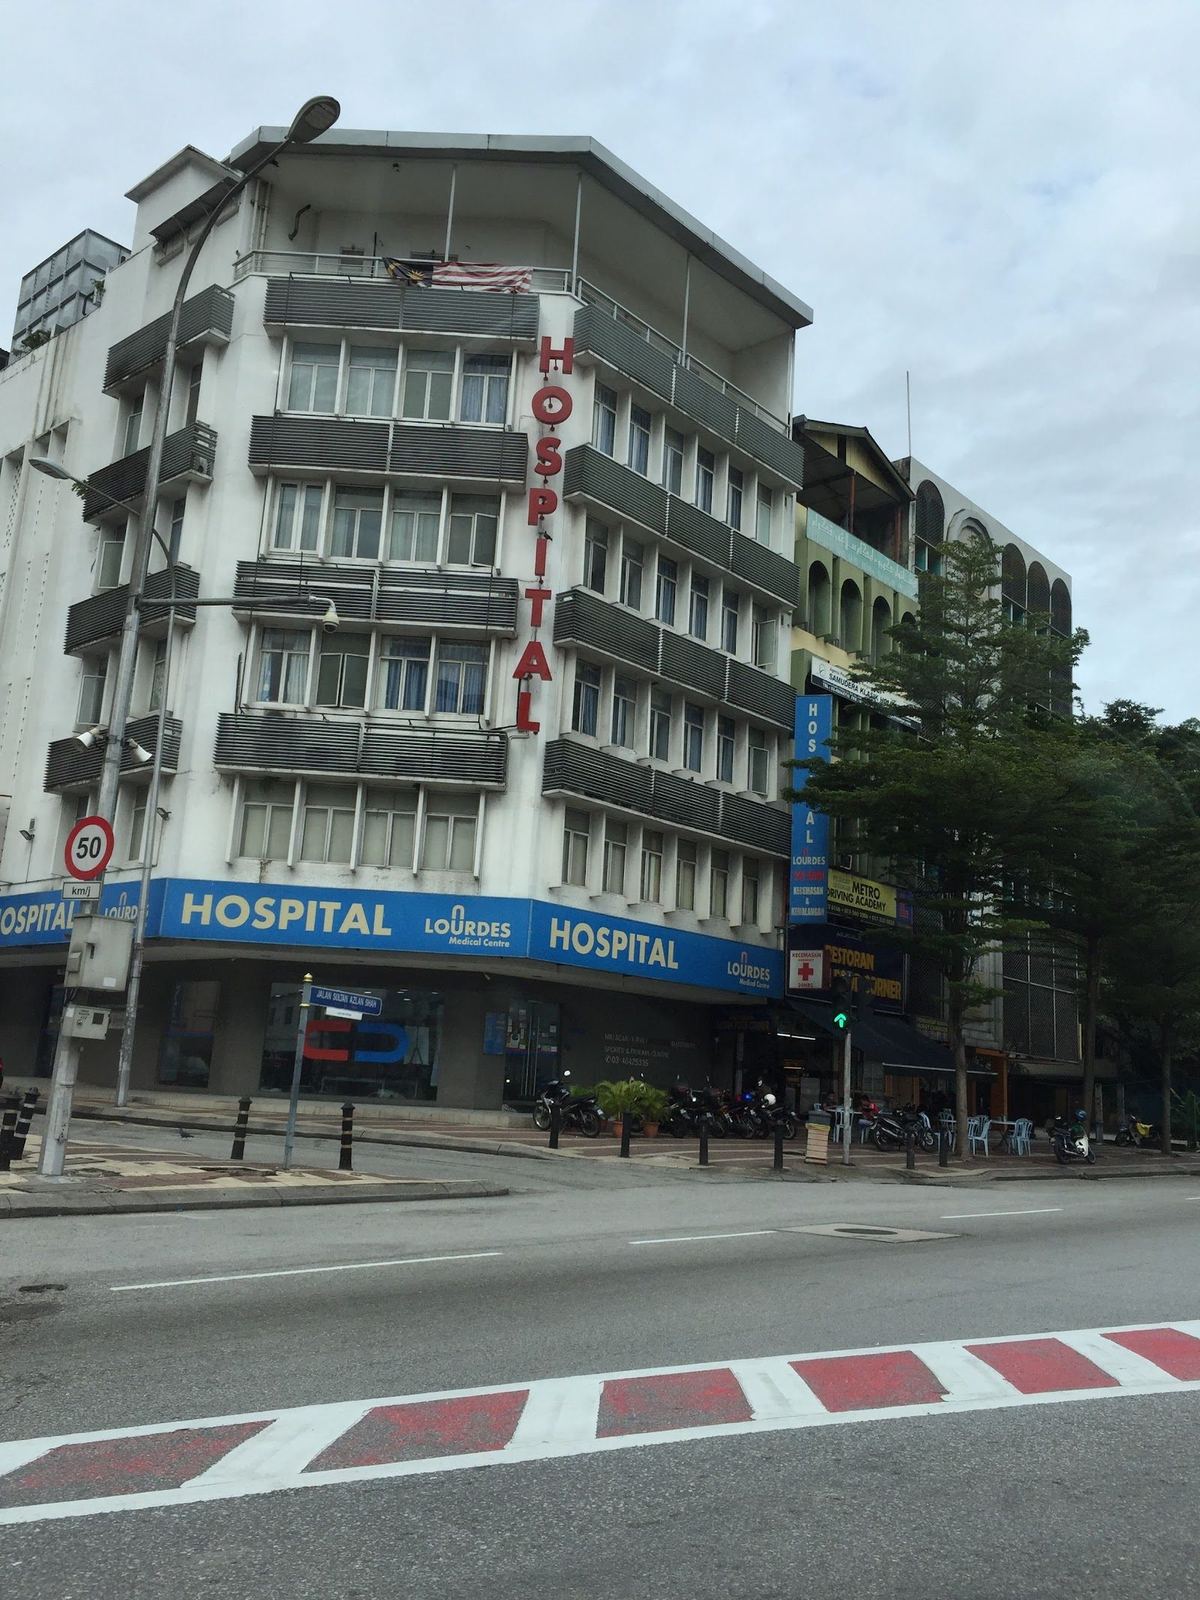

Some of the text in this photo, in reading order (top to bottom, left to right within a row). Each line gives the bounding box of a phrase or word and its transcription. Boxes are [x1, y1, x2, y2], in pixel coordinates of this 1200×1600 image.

[512, 336, 574, 734] HOSPITAL
[805, 703, 818, 844] HOSAL
[76, 837, 101, 859] 50
[792, 856, 826, 865] LOURDES
[71, 886, 91, 897] km/j
[852, 882, 881, 900] METRO
[181, 893, 392, 937] HOSPITAL
[855, 895, 887, 912] ACADEMY
[0, 901, 75, 936] OSPITAL
[425, 904, 512, 939] LOURDES
[448, 936, 511, 949] Medical Centre
[549, 917, 679, 970] HOSPITAL
[727, 956, 770, 981] LOURDES
[316, 990, 332, 1000] JALAN
